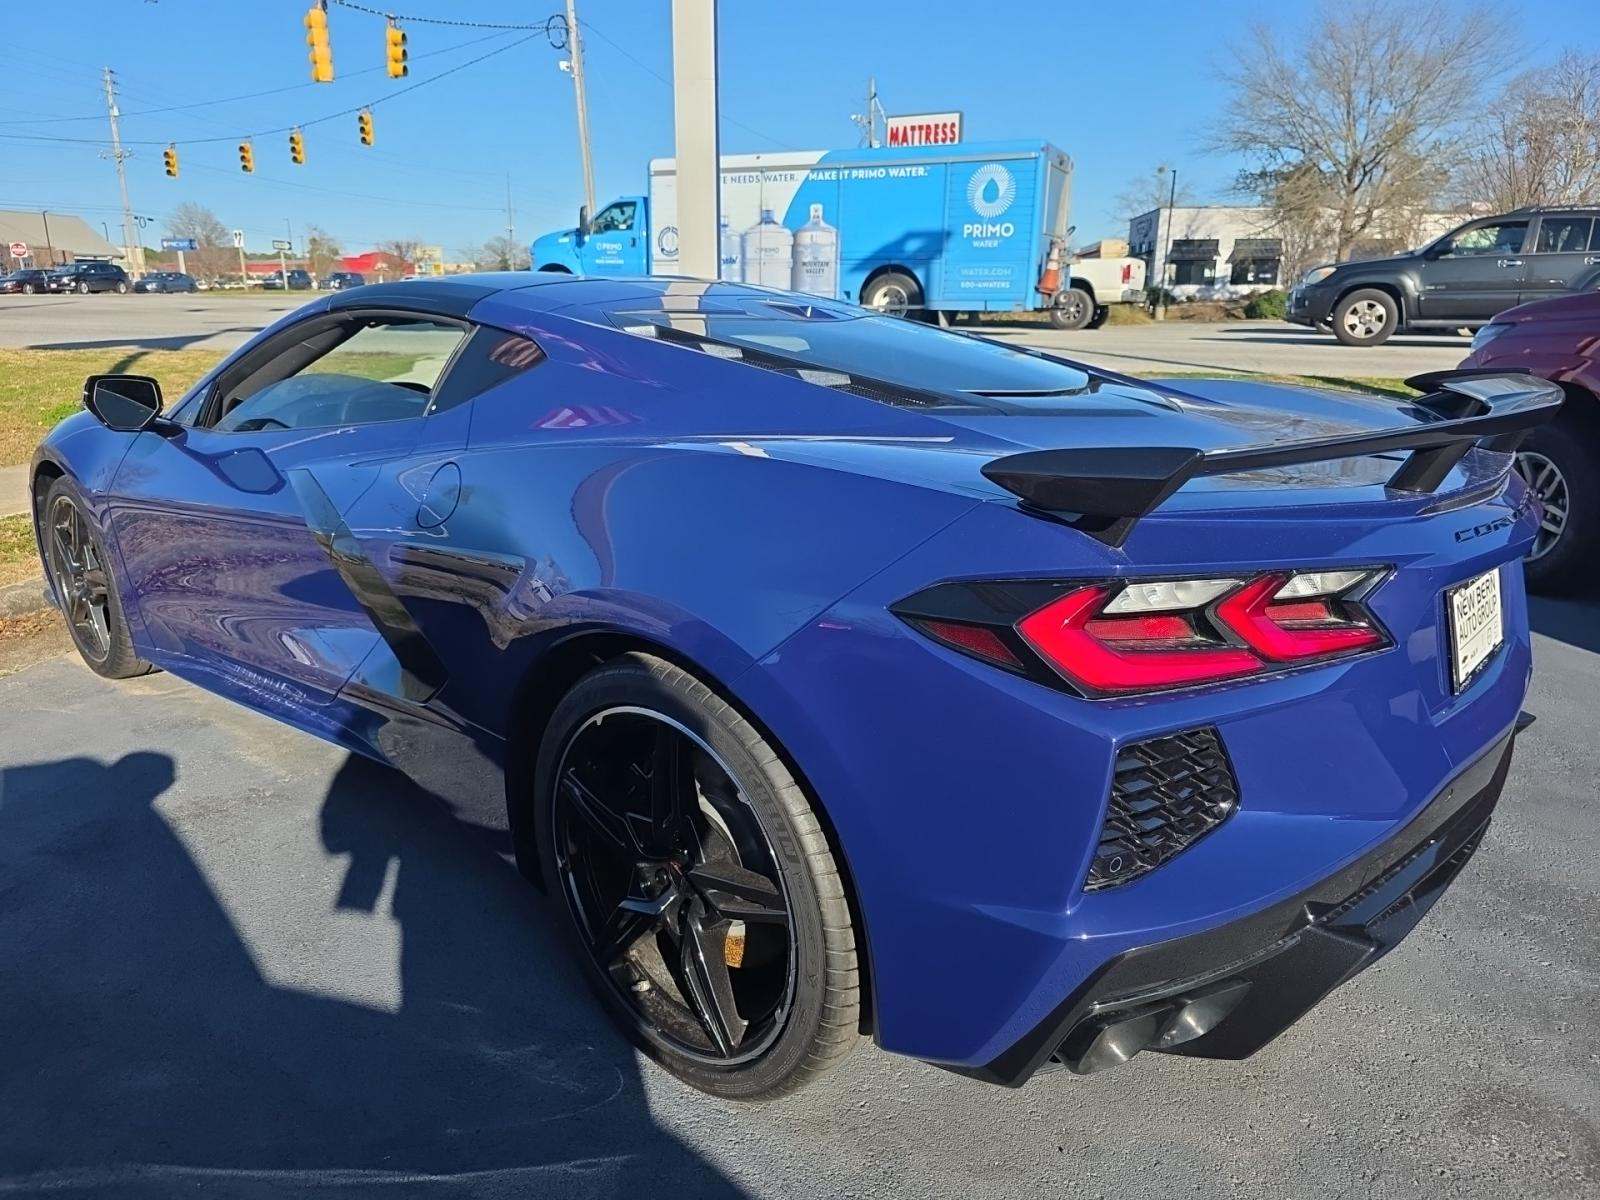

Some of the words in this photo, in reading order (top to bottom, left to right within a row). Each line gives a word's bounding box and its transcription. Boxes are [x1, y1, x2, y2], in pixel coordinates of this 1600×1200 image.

[890, 122, 956, 145] MATTRESS
[730, 175, 760, 184] NEEDS
[809, 171, 838, 181] MAKE
[840, 171, 849, 180] IT
[852, 168, 885, 179] PRIMO
[963, 222, 1015, 238] PRIMO
[973, 240, 998, 248] WATER
[1457, 590, 1476, 619] NEW
[1476, 573, 1496, 604] BERN
[1459, 612, 1477, 642] AUTO
[1477, 594, 1498, 626] GROUP
